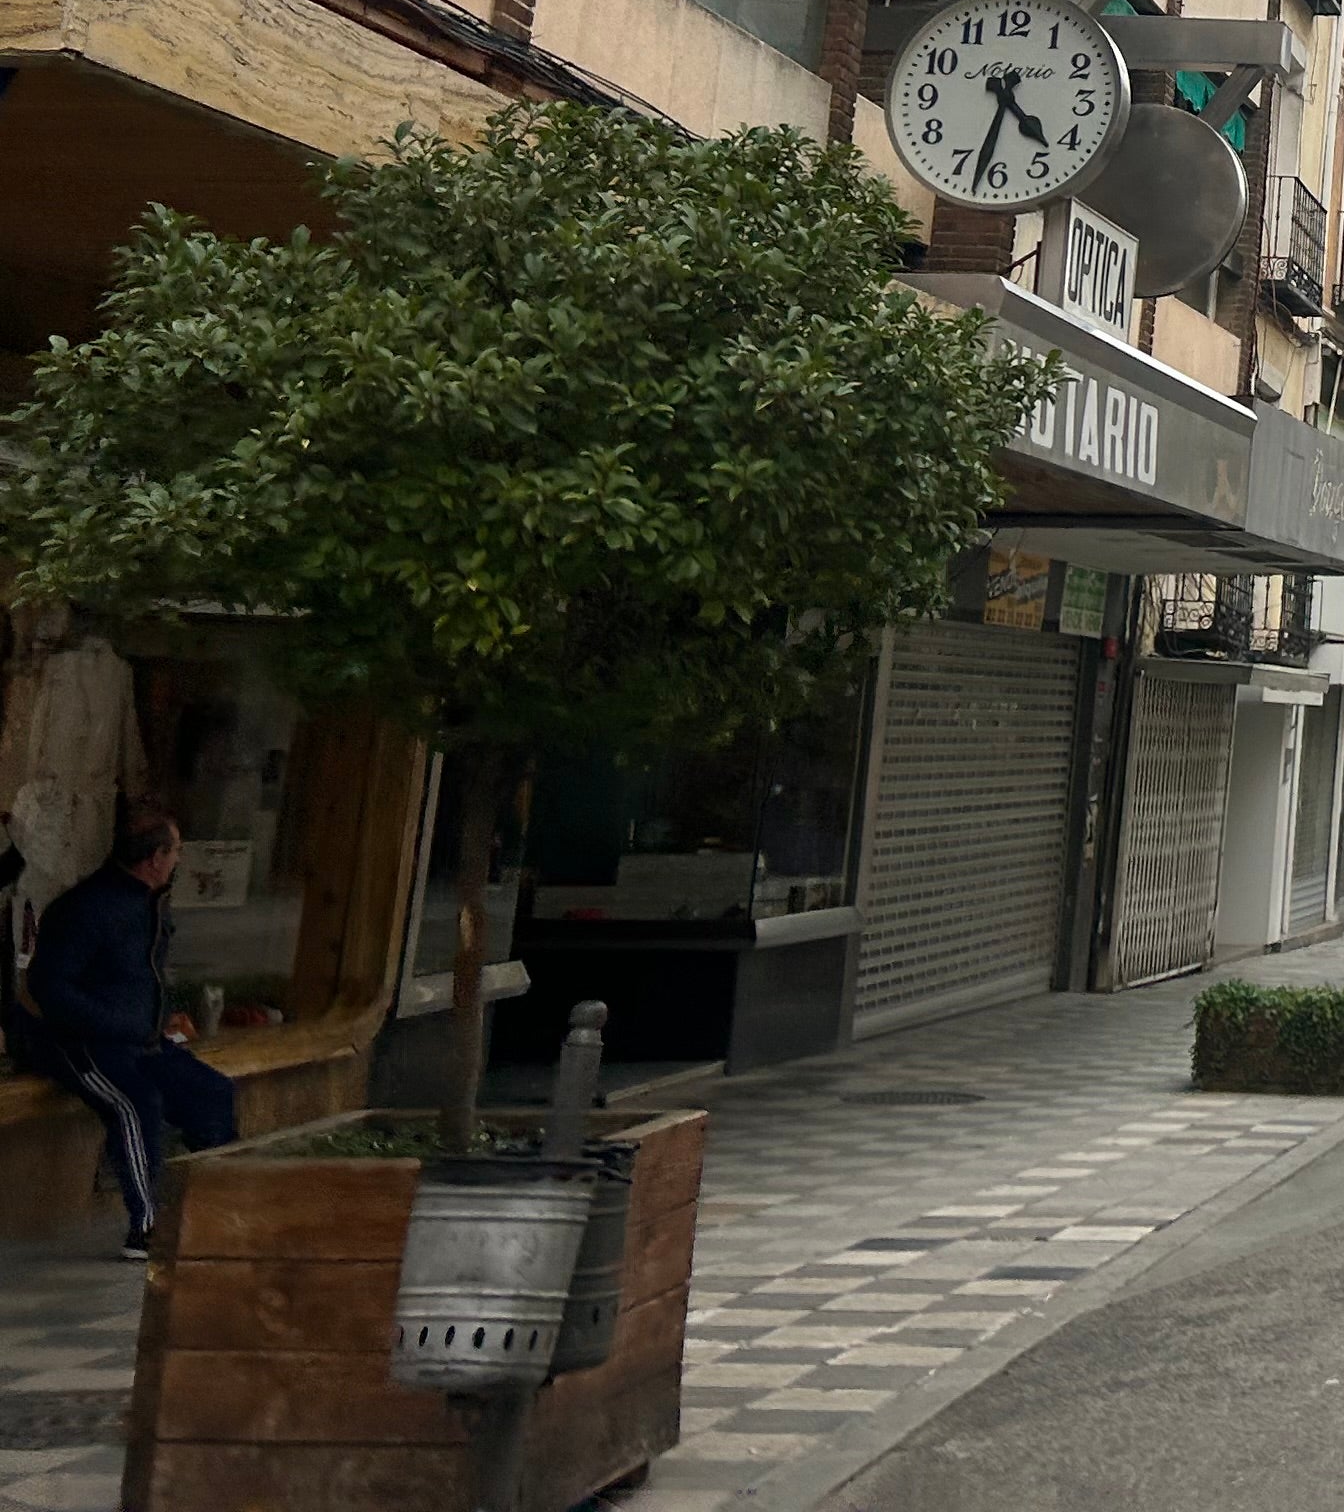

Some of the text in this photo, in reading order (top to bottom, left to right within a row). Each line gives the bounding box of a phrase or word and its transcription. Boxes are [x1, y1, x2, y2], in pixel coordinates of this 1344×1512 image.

[960, 17, 984, 45] 11
[997, 9, 1031, 38] 12
[1048, 22, 1060, 49] 1
[925, 48, 958, 76] 10
[964, 61, 1056, 80] Notario
[1068, 53, 1091, 80] 2
[917, 84, 939, 110] 9
[1072, 89, 1095, 116] 3
[921, 119, 943, 145] 8
[1057, 124, 1081, 151] 4
[951, 149, 974, 176] 7
[987, 162, 1008, 189] 6
[1026, 152, 1049, 179] 5
[1067, 216, 1127, 329] OPTICA
